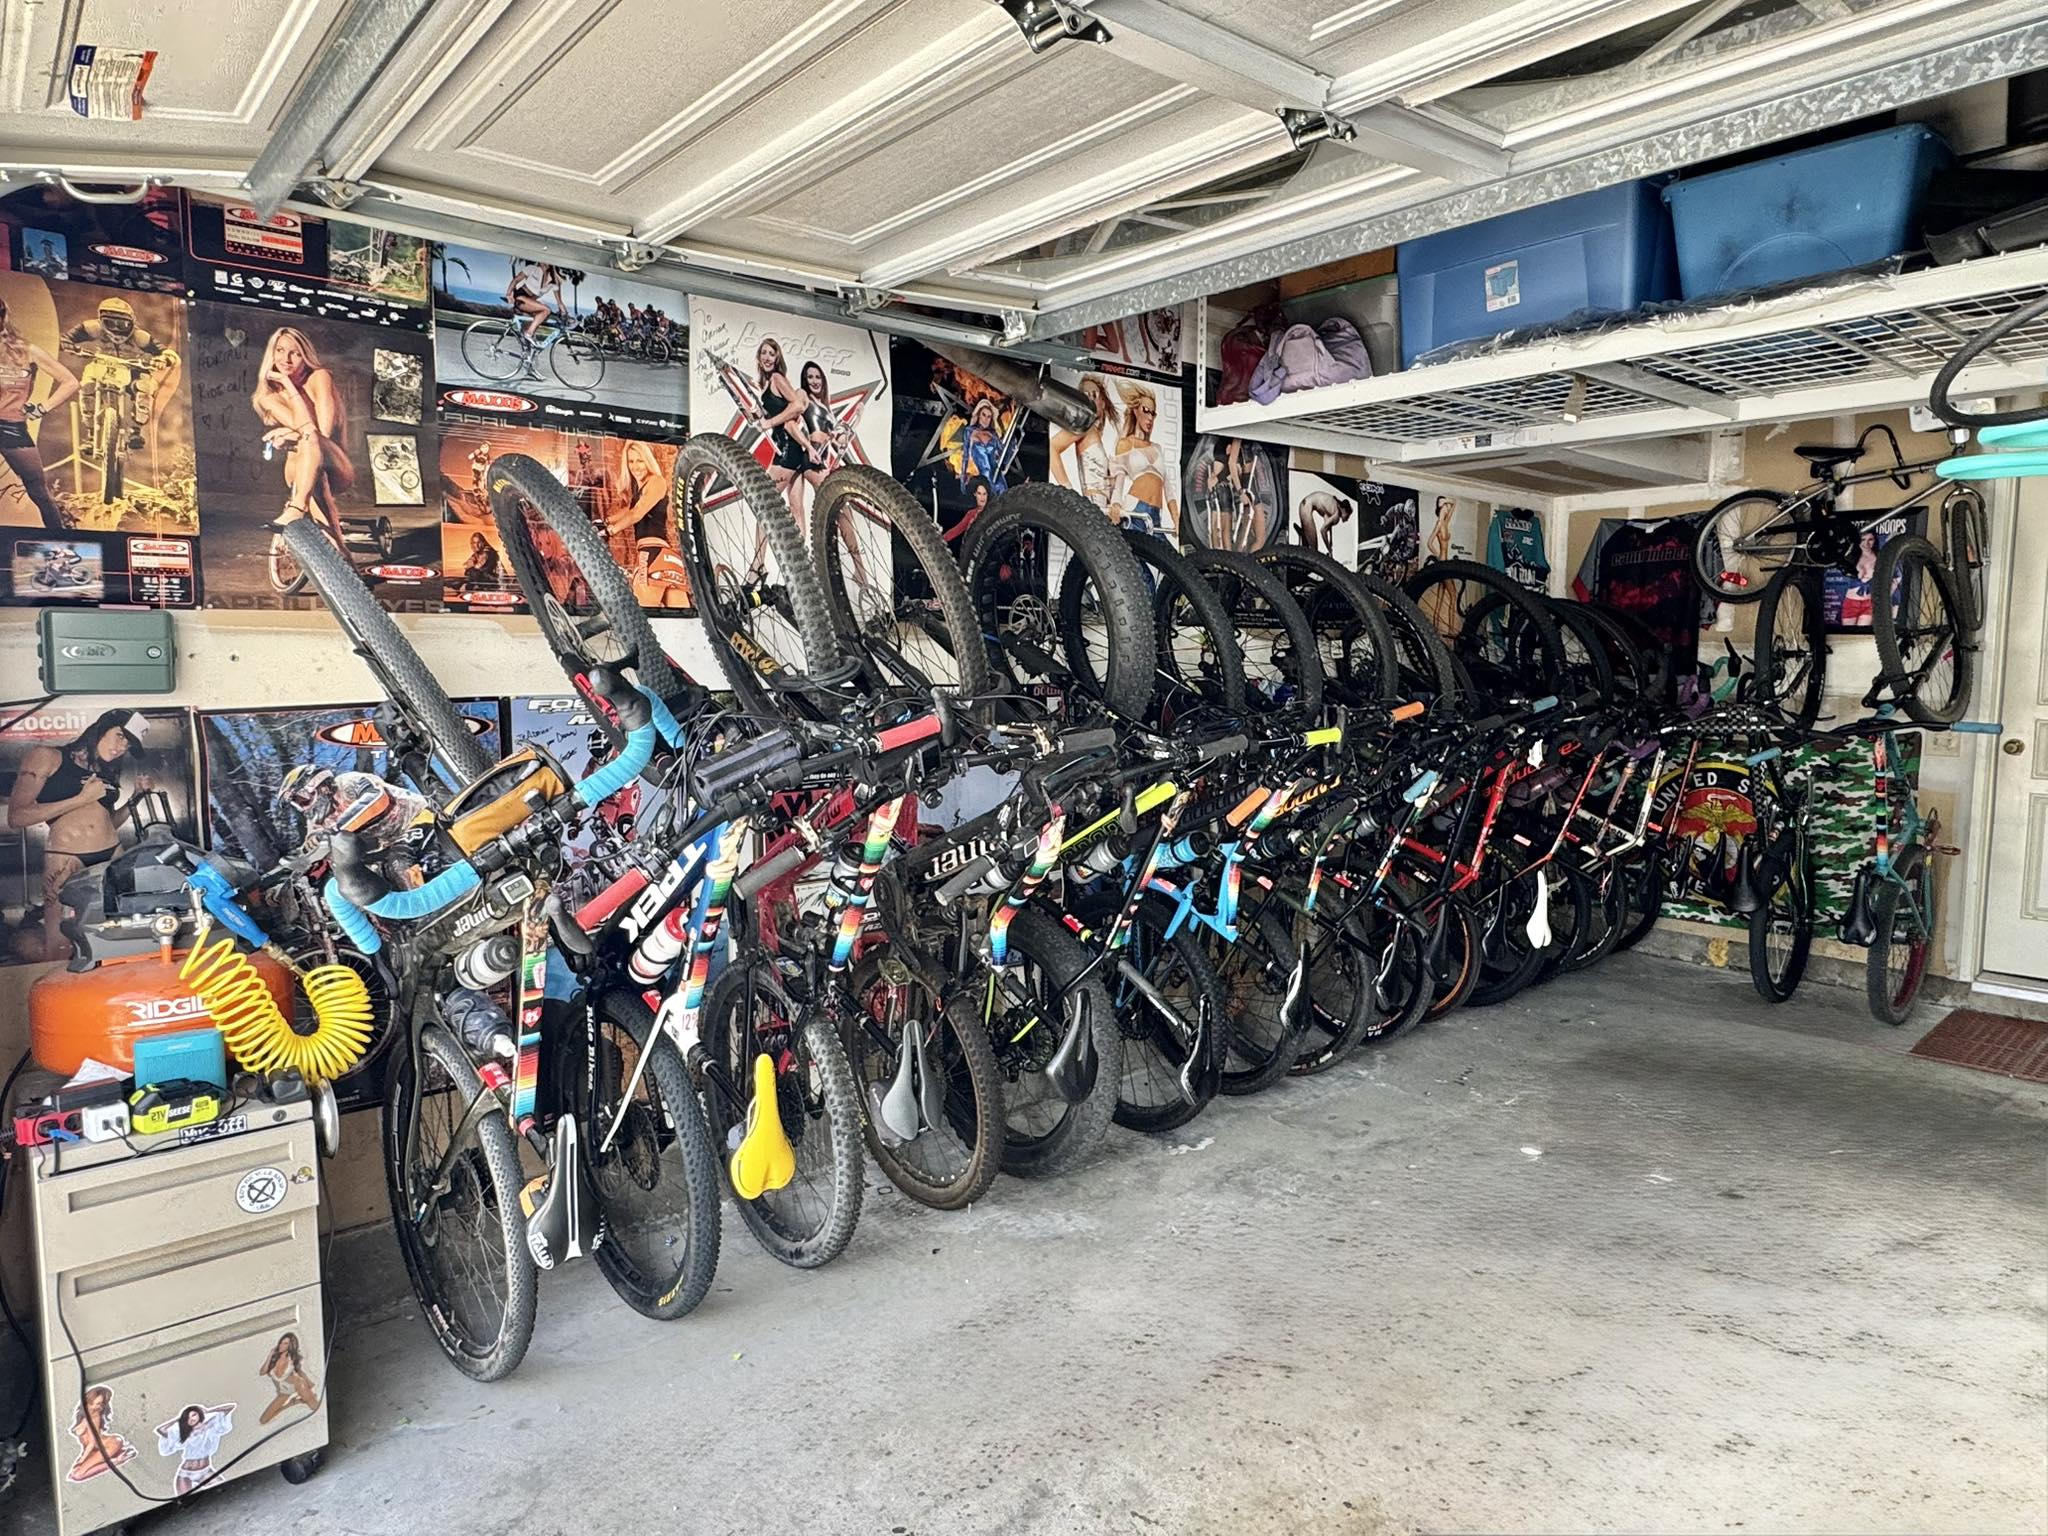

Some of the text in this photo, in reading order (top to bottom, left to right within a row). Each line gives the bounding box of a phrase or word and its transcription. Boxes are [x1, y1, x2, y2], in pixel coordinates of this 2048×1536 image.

[462, 392, 523, 411] MAXXIS
[676, 477, 686, 531] MAXXIS
[527, 698, 587, 711] FOE
[1652, 771, 1718, 813] UNIED
[618, 841, 708, 944] TREK
[151, 1109, 167, 1121] 21V
